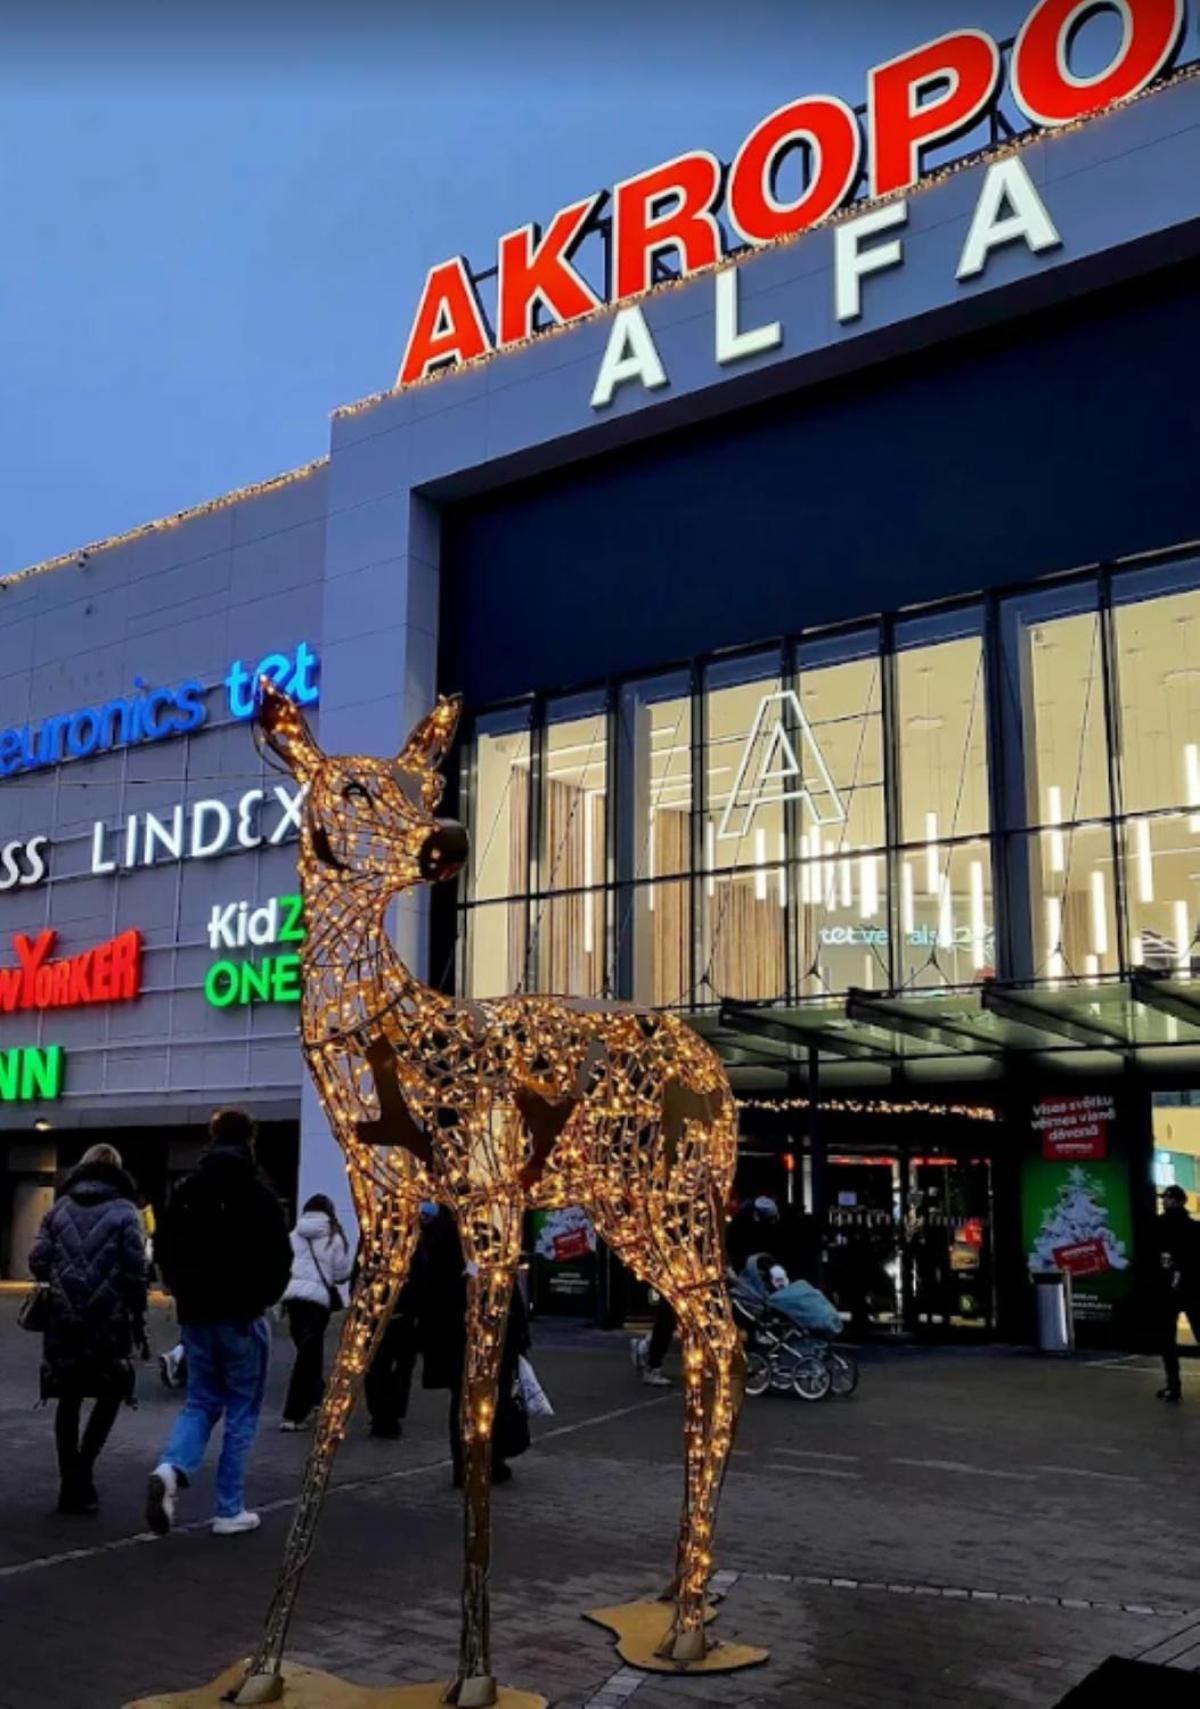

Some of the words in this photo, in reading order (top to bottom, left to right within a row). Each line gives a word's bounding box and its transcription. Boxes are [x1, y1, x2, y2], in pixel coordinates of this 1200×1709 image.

[399, 0, 1184, 386] AKROPO
[590, 156, 1064, 410] ALFA
[0, 676, 206, 776] euronics
[91, 781, 310, 874] LINDEX
[204, 955, 301, 1008] ONE
